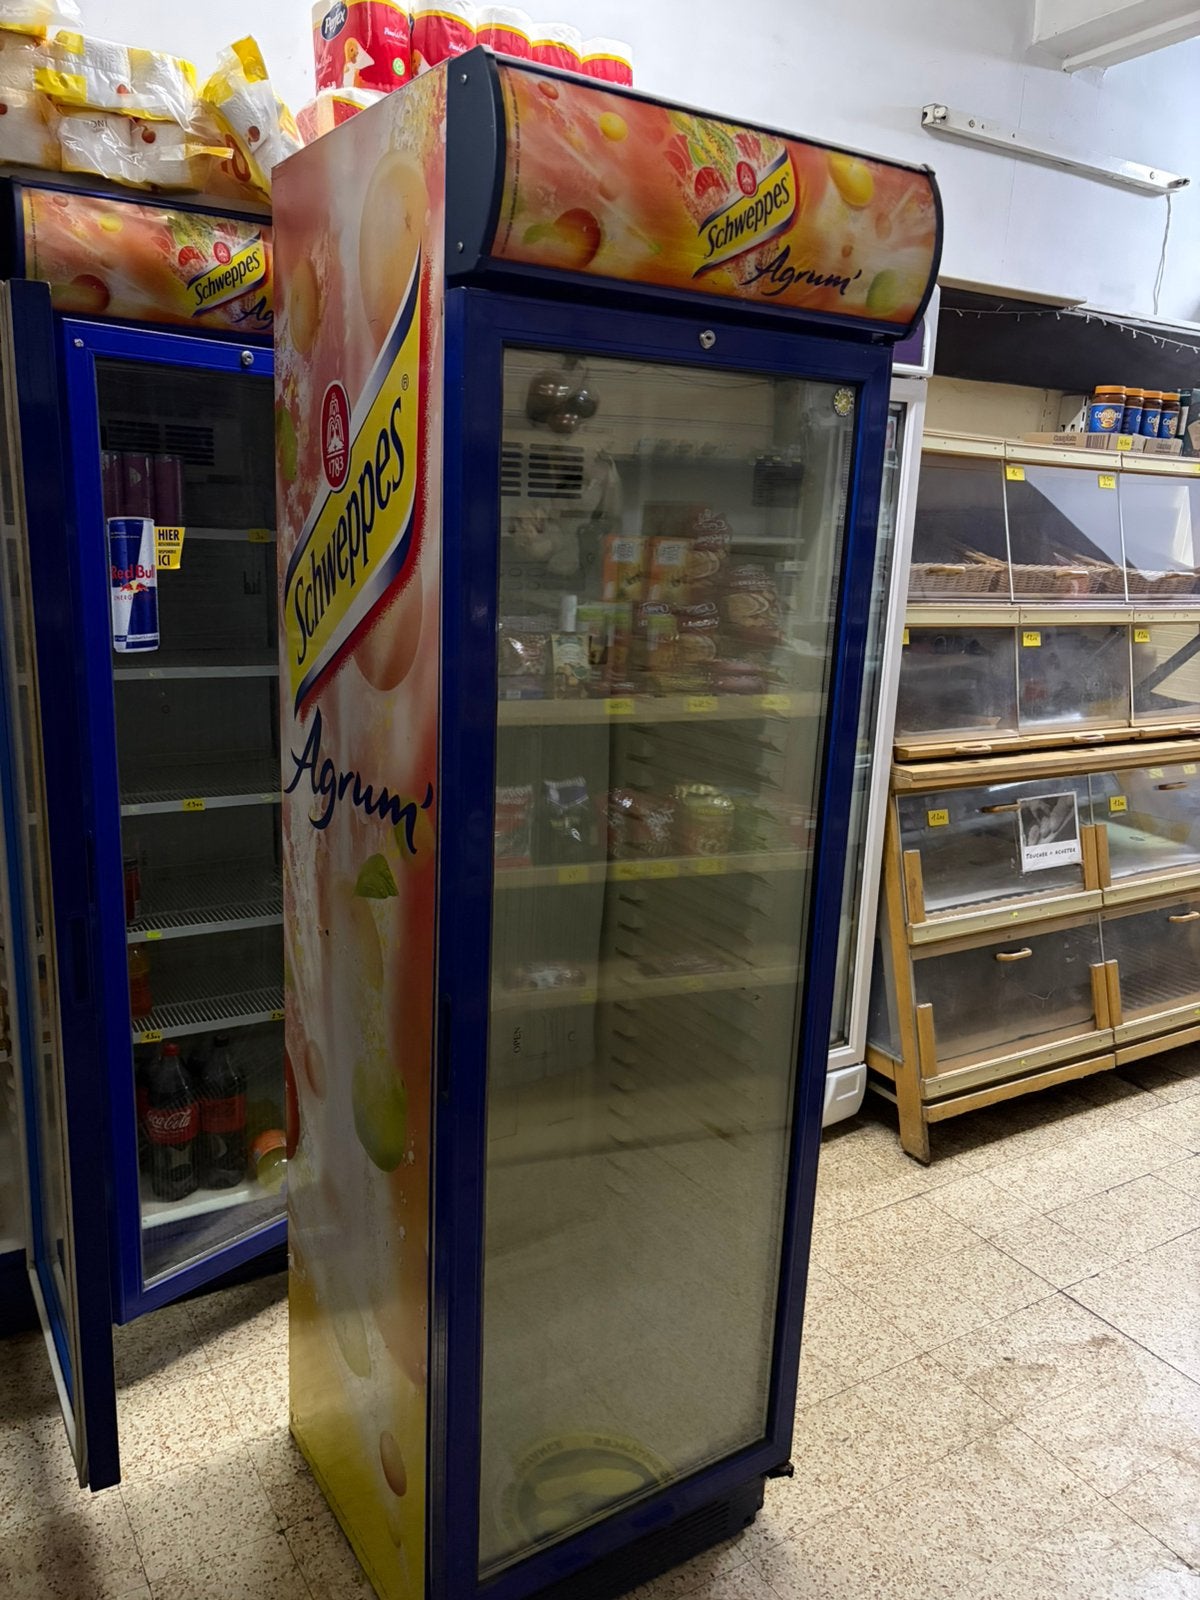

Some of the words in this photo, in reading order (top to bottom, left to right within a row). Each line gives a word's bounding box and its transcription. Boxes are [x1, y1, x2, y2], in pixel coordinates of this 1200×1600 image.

[703, 175, 791, 258] Schweppes
[194, 251, 261, 306] Schweppes
[327, 455, 345, 478] 1783
[158, 529, 180, 540] HIER
[296, 395, 405, 665] Schweppes
[158, 554, 171, 566] ICI
[111, 564, 134, 580] Red
